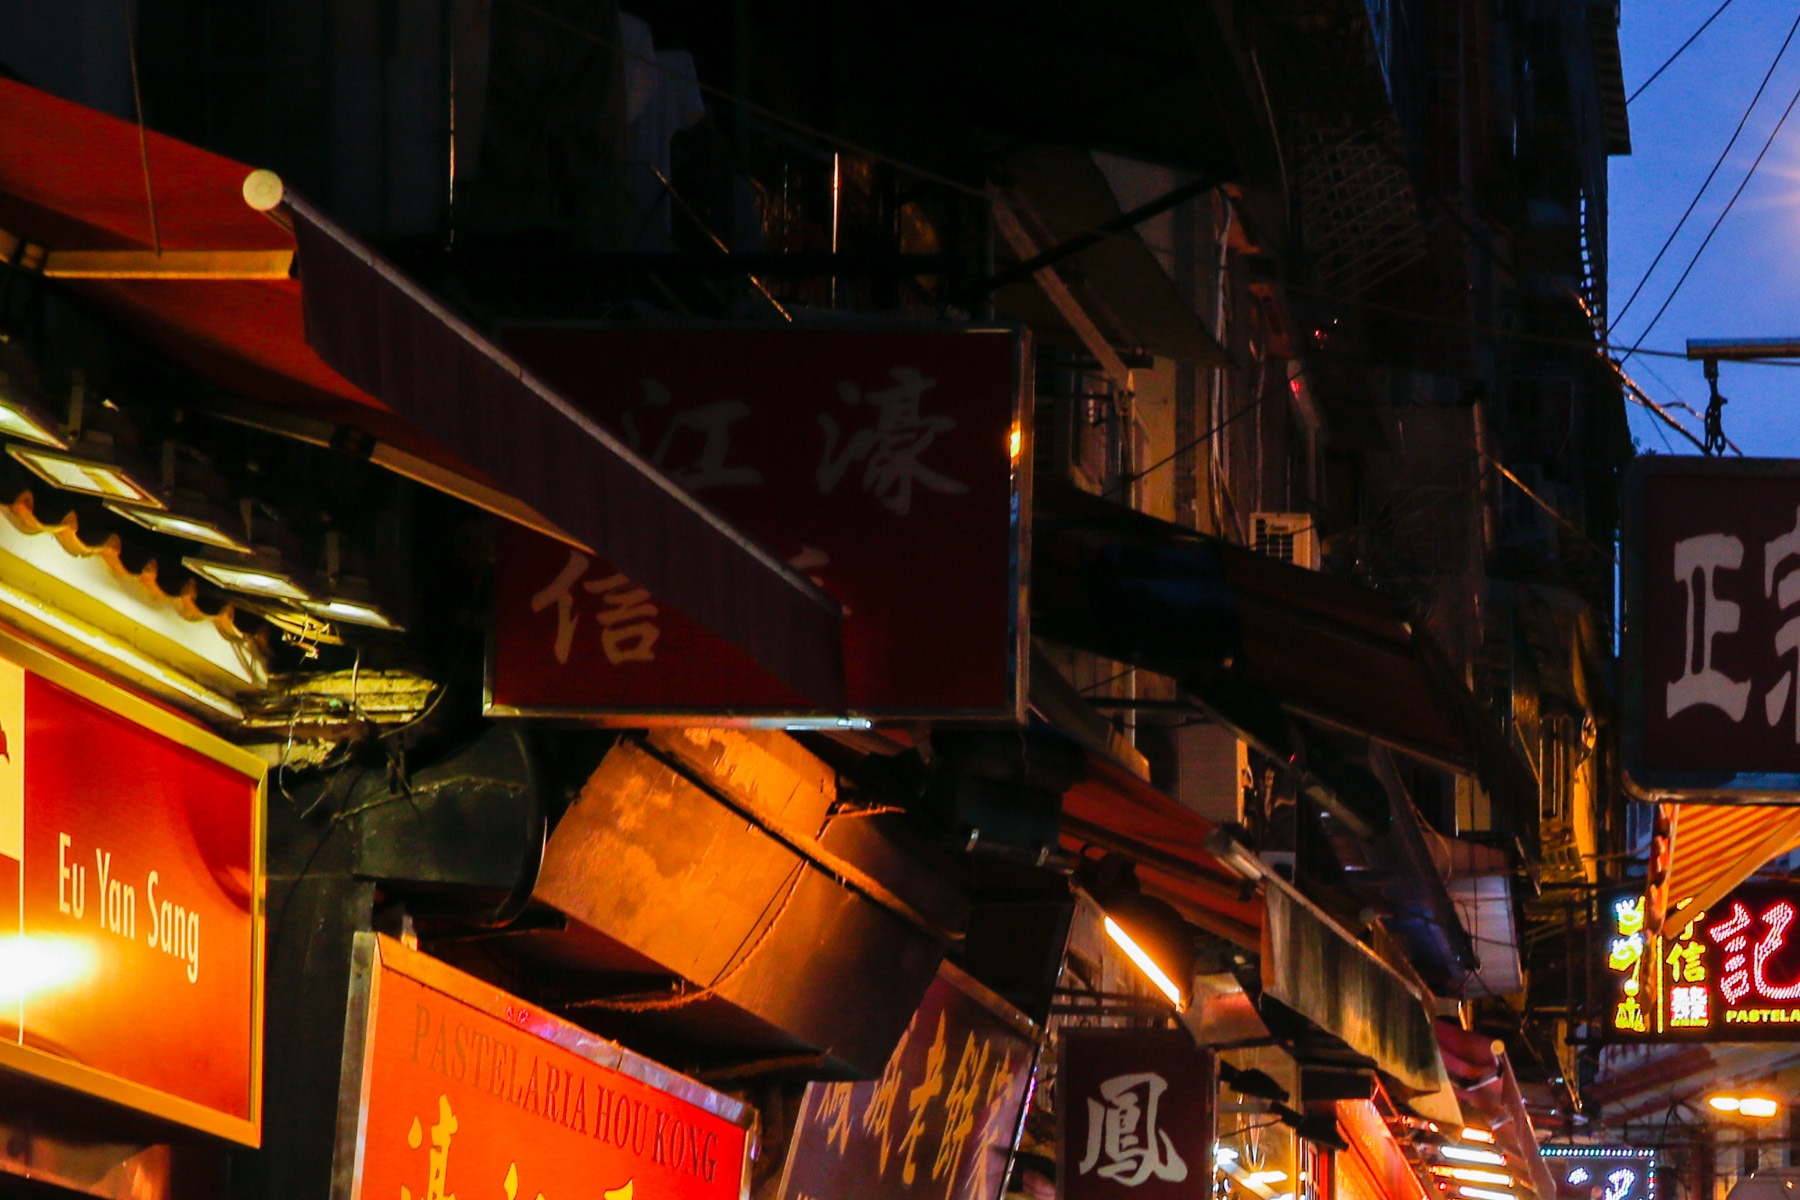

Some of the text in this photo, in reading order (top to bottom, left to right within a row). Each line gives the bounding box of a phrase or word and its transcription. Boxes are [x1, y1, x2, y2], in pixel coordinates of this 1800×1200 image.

[56, 830, 201, 984] Eu Yan Sang
[410, 1002, 719, 1185] PASTELARIA HOU KONG
